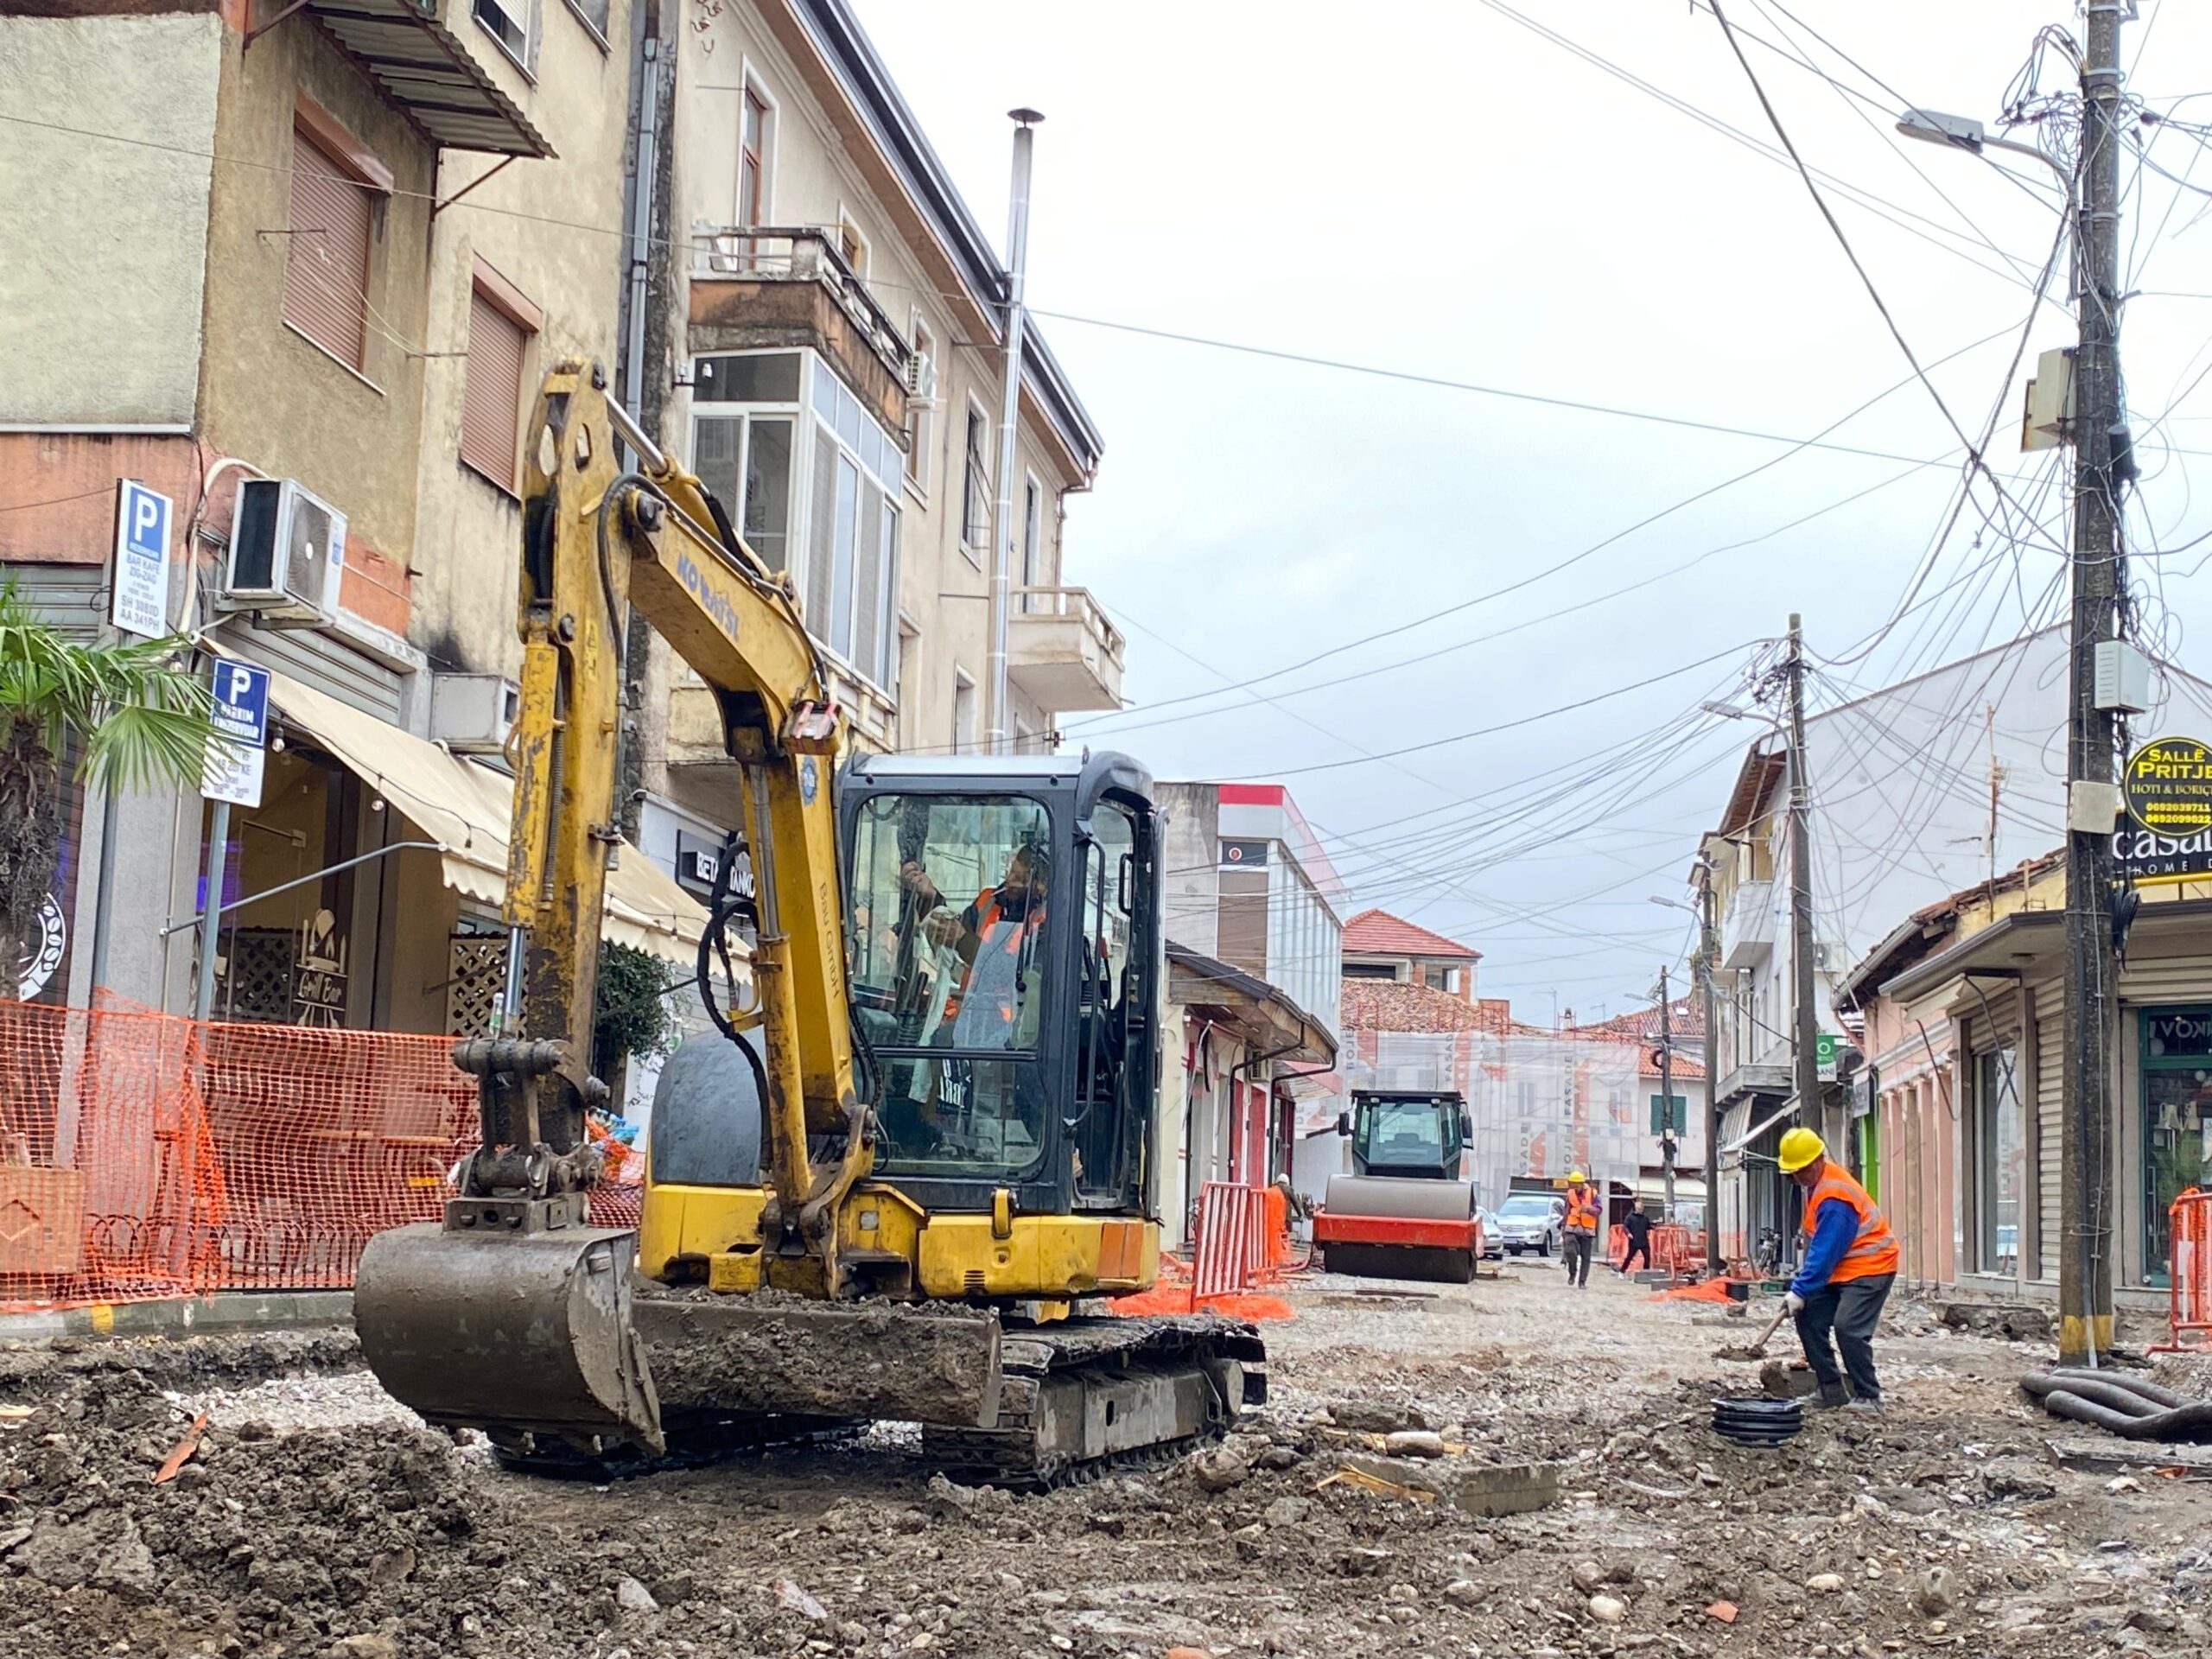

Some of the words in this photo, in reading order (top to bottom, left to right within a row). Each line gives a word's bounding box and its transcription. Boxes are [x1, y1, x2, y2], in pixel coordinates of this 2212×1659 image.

[135, 493, 158, 543] P
[230, 668, 251, 704] P
[2148, 748, 2205, 762] SALLË
[2131, 783, 2160, 794] HOTI
[2163, 783, 2172, 794] &
[2175, 784, 2212, 797] BORIÇ
[819, 882, 830, 927] Bau
[825, 931, 840, 999] GmbH
